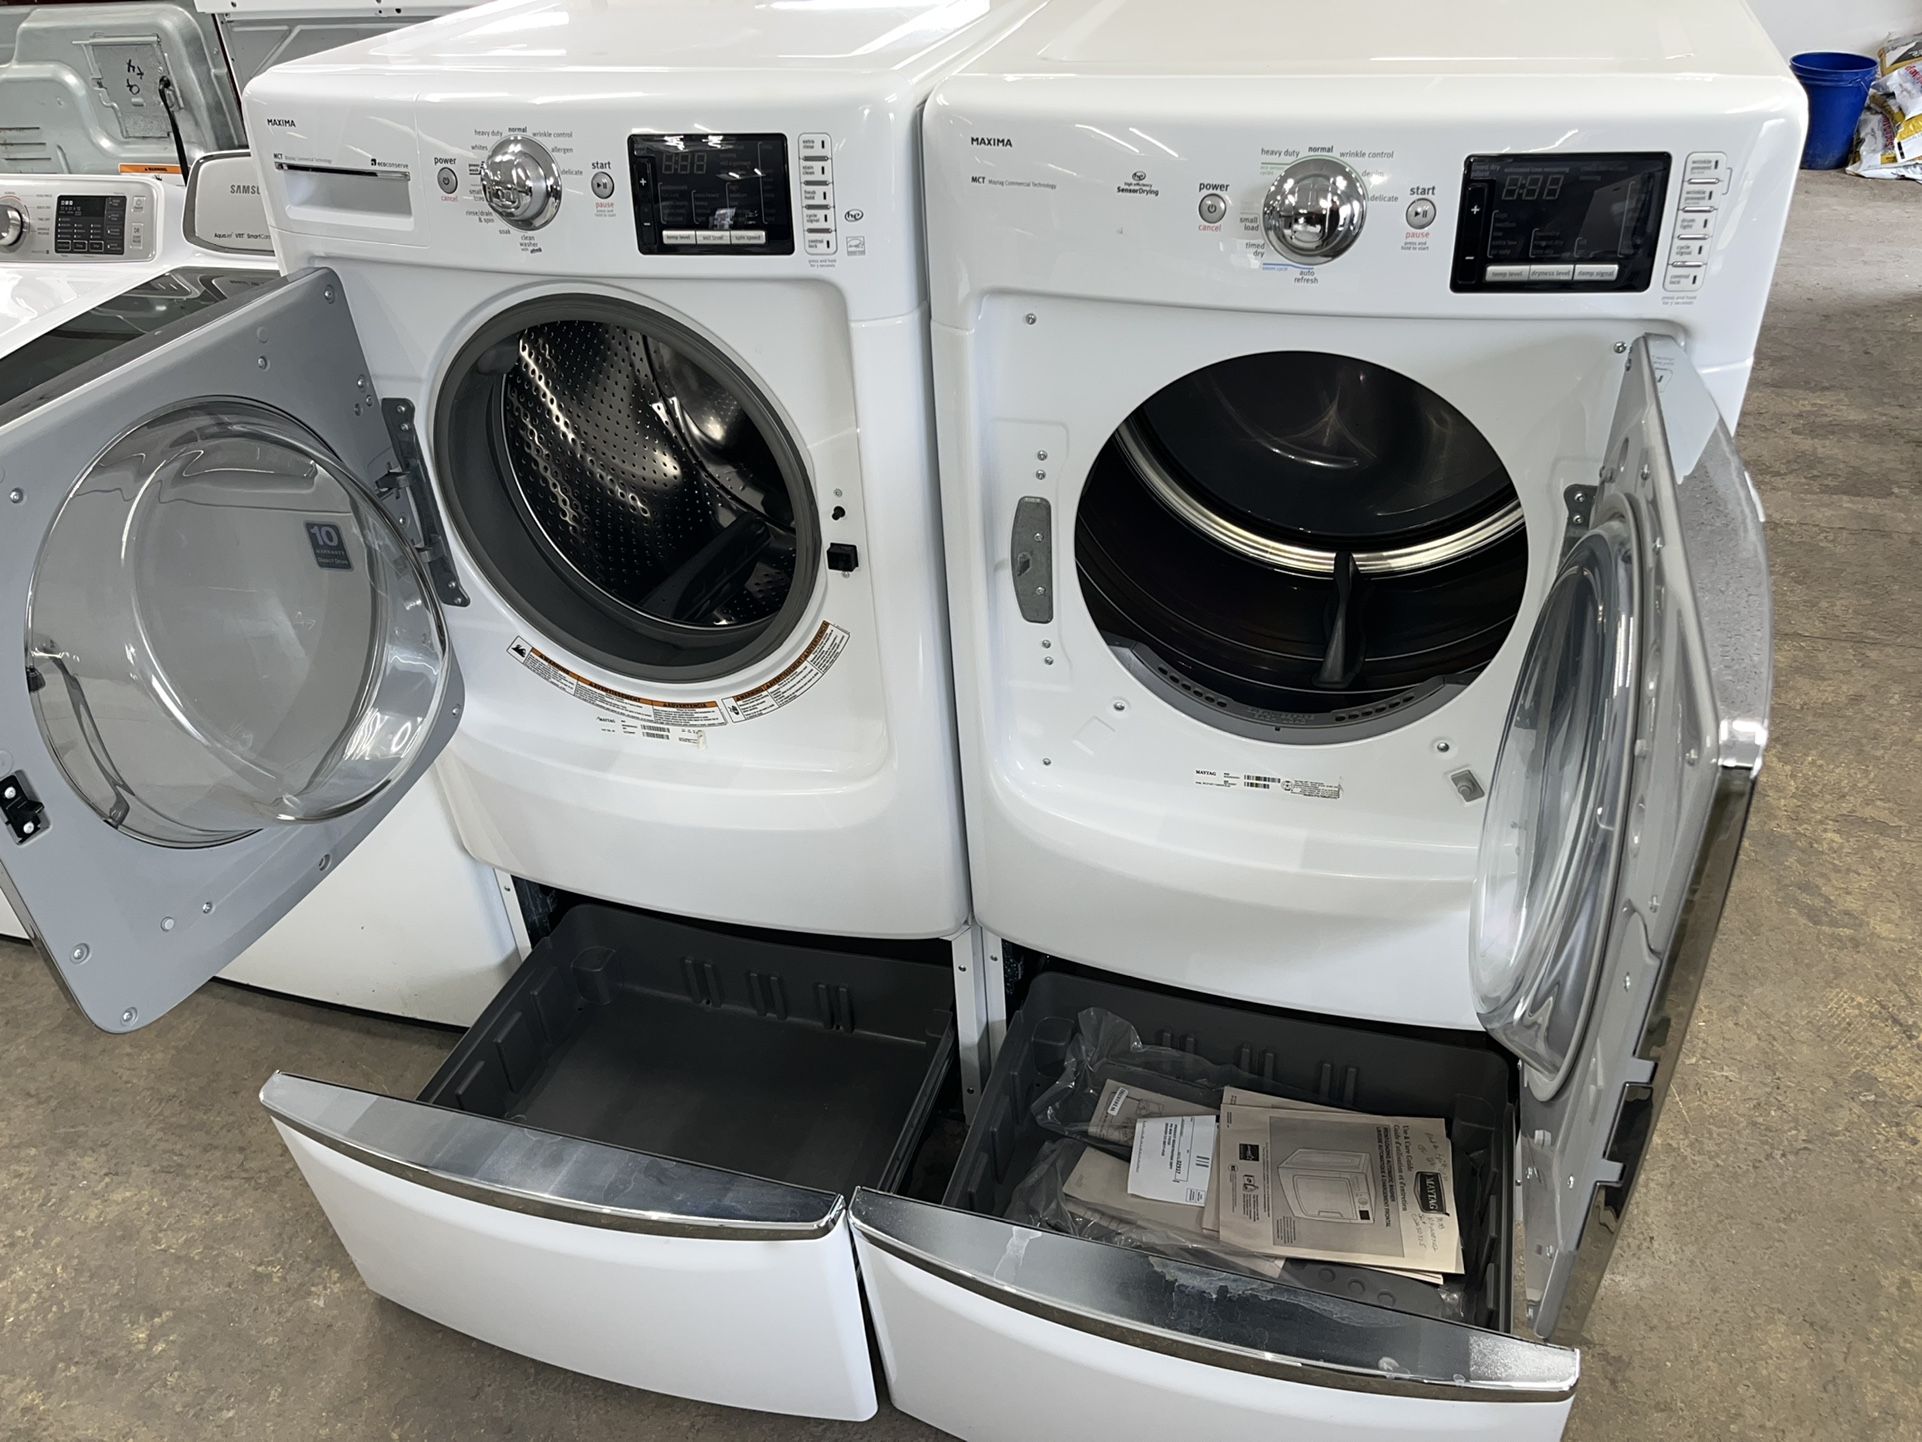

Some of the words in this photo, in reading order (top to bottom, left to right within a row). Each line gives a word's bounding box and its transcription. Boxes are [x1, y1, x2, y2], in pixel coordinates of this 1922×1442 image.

[267, 118, 297, 127] MAXIMA
[474, 129, 490, 137] heavy
[971, 136, 1012, 148] MAXIMA
[551, 146, 573, 154] allergen
[1261, 148, 1282, 158] heavy
[1284, 149, 1300, 158] duty
[1339, 150, 1366, 159] wrinkle
[1368, 151, 1394, 159] control
[377, 161, 409, 169] ecoconserve
[434, 157, 457, 166] power
[591, 161, 612, 170] start
[971, 176, 986, 184] MCT
[988, 179, 1004, 187] Maytag
[1005, 179, 1031, 188] Commercial
[1031, 181, 1057, 190] Technology
[1199, 182, 1230, 193] power
[1117, 187, 1159, 197] SensorDrying
[1410, 186, 1436, 196] start
[1370, 195, 1398, 203] delicate
[1199, 224, 1222, 232] cancel
[1405, 231, 1430, 239] pause
[1246, 242, 1265, 250] timed
[1253, 250, 1265, 258] dry
[1294, 276, 1318, 285] refresh
[310, 526, 338, 546] 10
[1196, 769, 1217, 777] MAYTAG
[1402, 1125, 1410, 1135] Use
[1406, 1155, 1414, 1172] Guide
[1426, 1174, 1438, 1210] MAYTAG
